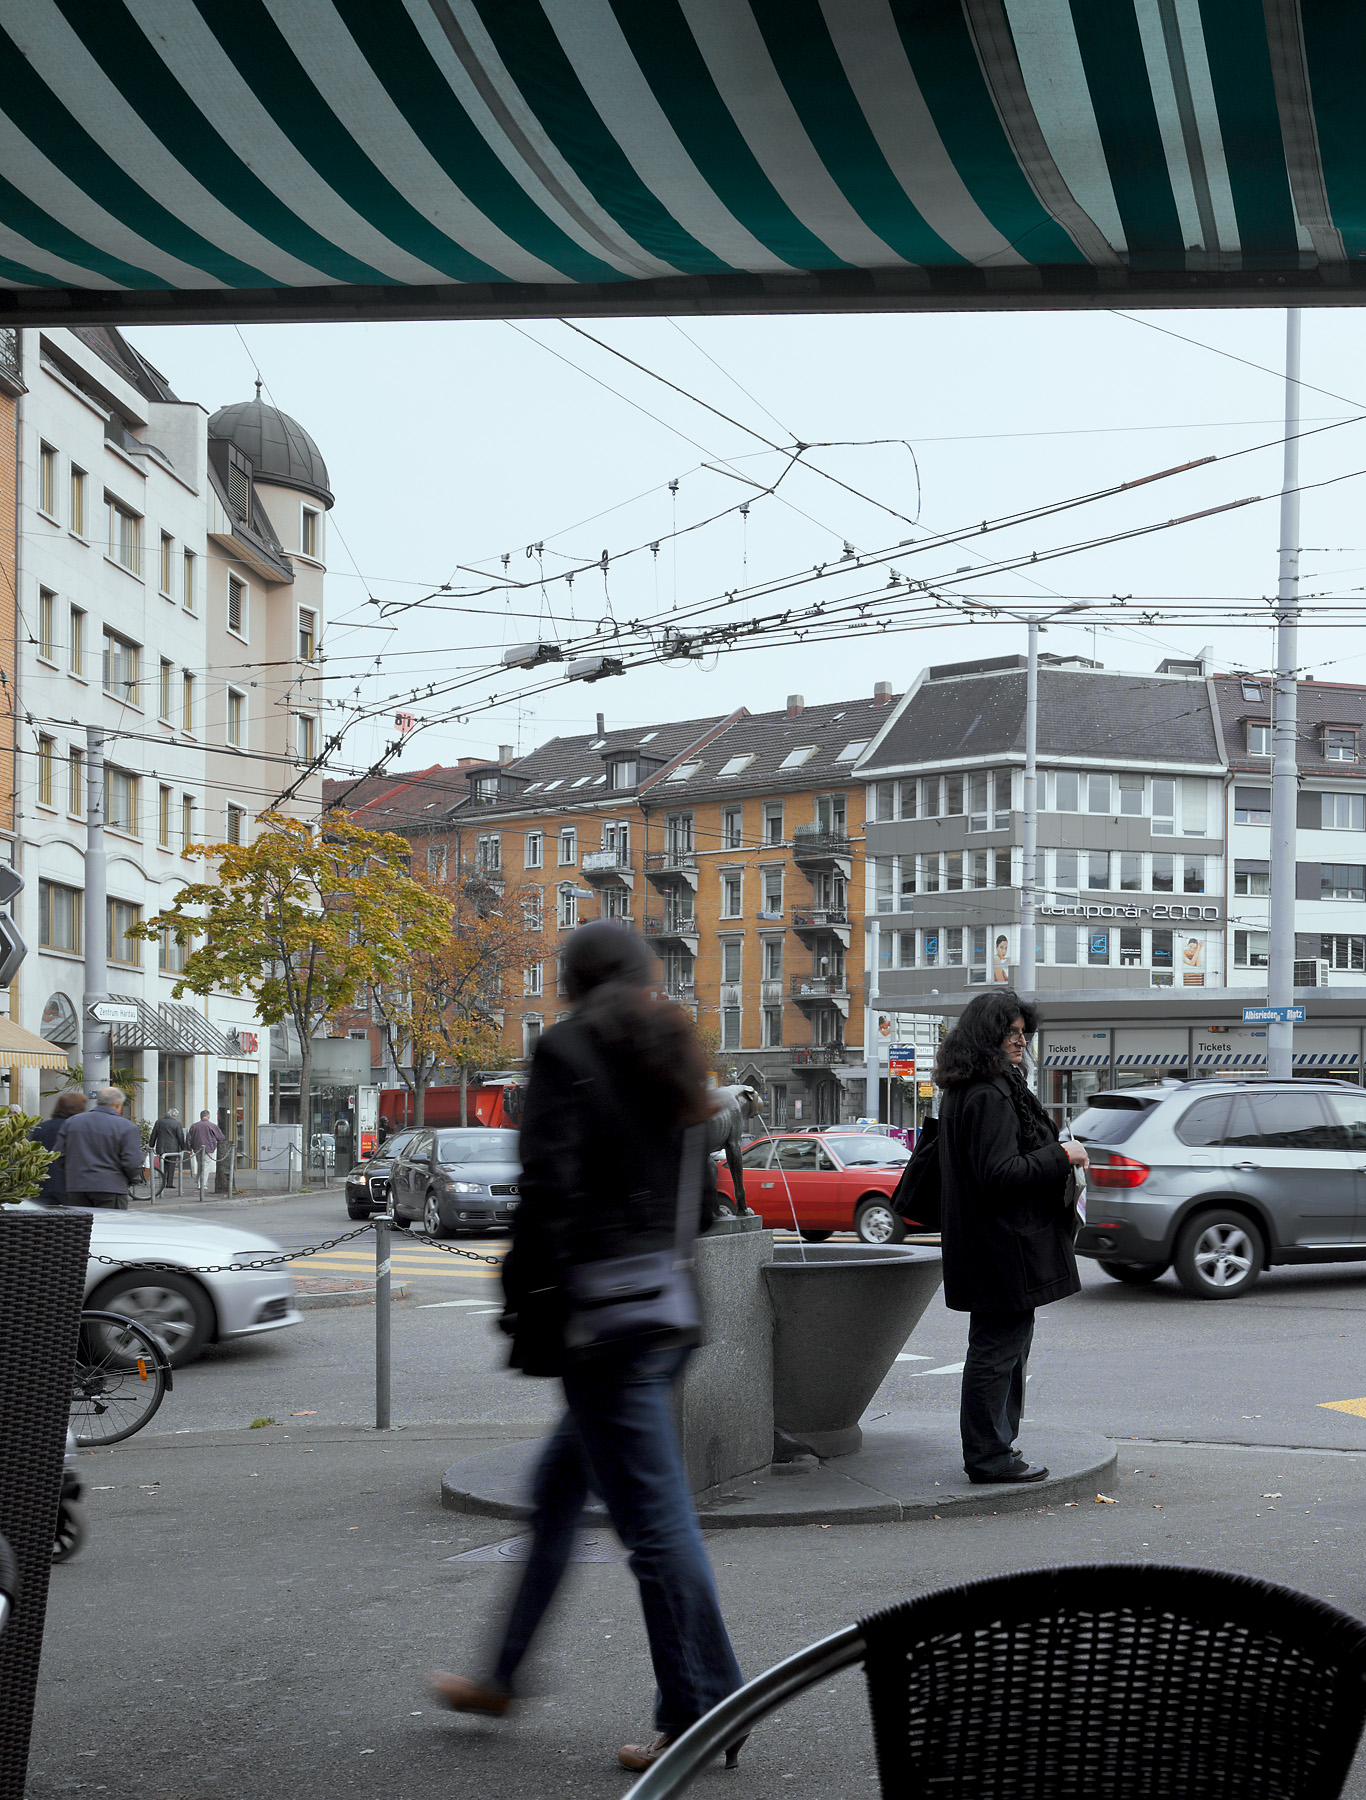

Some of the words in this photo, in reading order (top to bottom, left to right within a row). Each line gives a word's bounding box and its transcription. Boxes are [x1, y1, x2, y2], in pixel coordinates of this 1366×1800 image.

[1040, 902, 1150, 920] temporär
[1152, 903, 1219, 921] 2000
[100, 1007, 118, 1017] Zentrum
[120, 1009, 136, 1018] Hardau
[1245, 1010, 1278, 1020] Albisrieder
[1286, 1009, 1303, 1019] Platz
[242, 1031, 259, 1053] UBS
[1199, 1043, 1232, 1052] Tickets
[1048, 1044, 1077, 1053] Tickets
